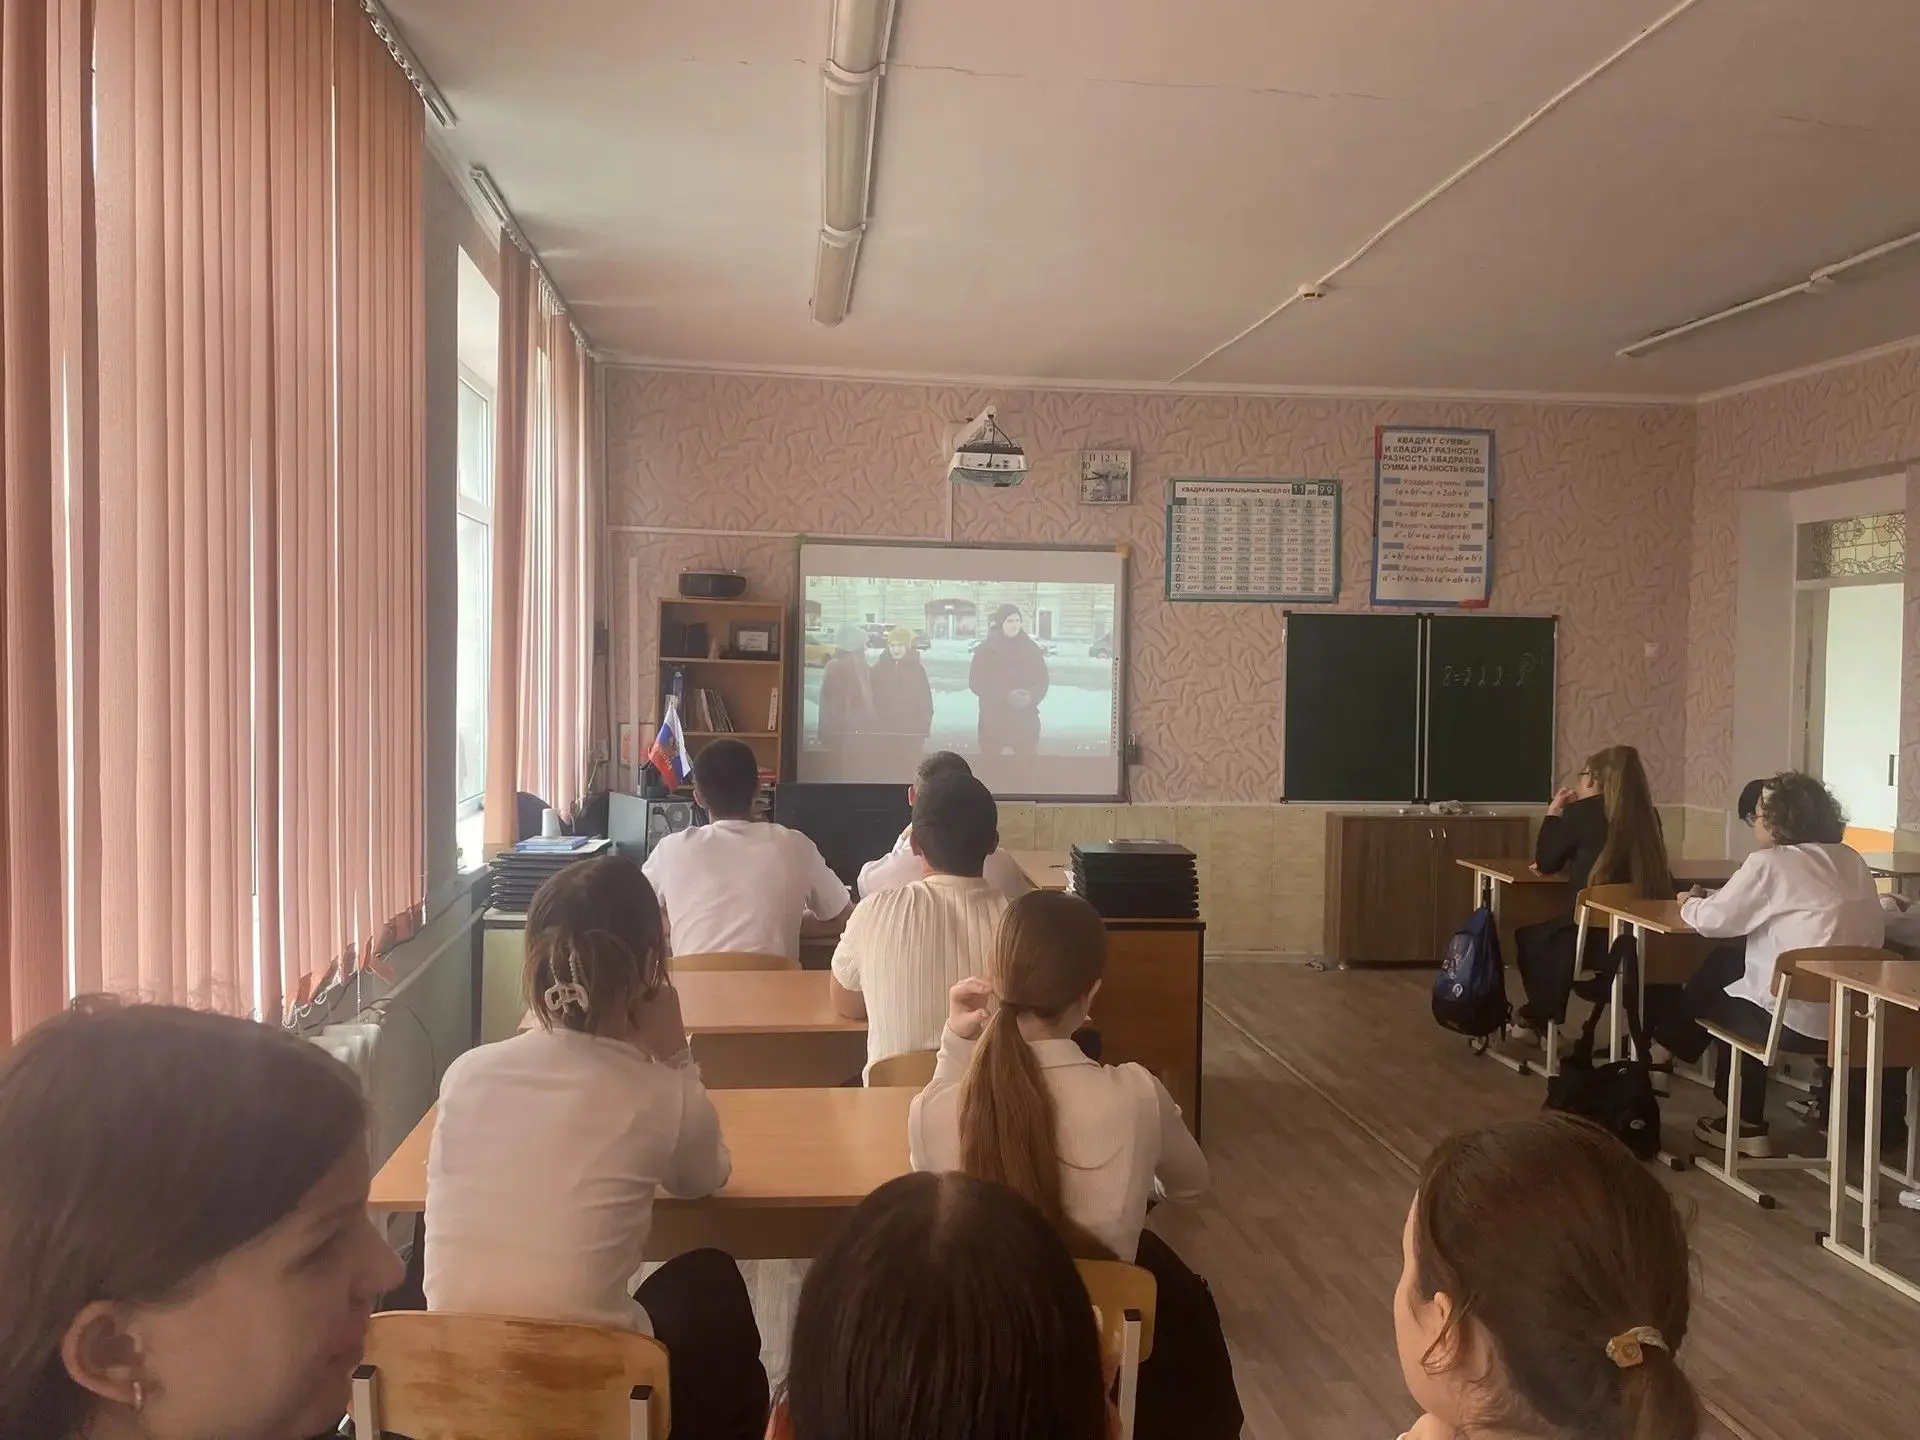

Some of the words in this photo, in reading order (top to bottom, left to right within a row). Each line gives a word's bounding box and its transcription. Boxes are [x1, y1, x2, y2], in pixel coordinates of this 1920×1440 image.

[1397, 436, 1436, 445] КВАДРАТ
[1439, 437, 1471, 446] СУММЫ
[1385, 445, 1391, 453] И
[1393, 446, 1433, 454] КВАДРАТ
[1101, 454, 1111, 462] 12
[1382, 454, 1428, 463] РАЗНОСТЬ
[1382, 463, 1409, 471] СУММА
[1418, 465, 1459, 473] РАЗНОСТЬ
[1293, 485, 1305, 495] 11
[1318, 485, 1333, 495] 99
